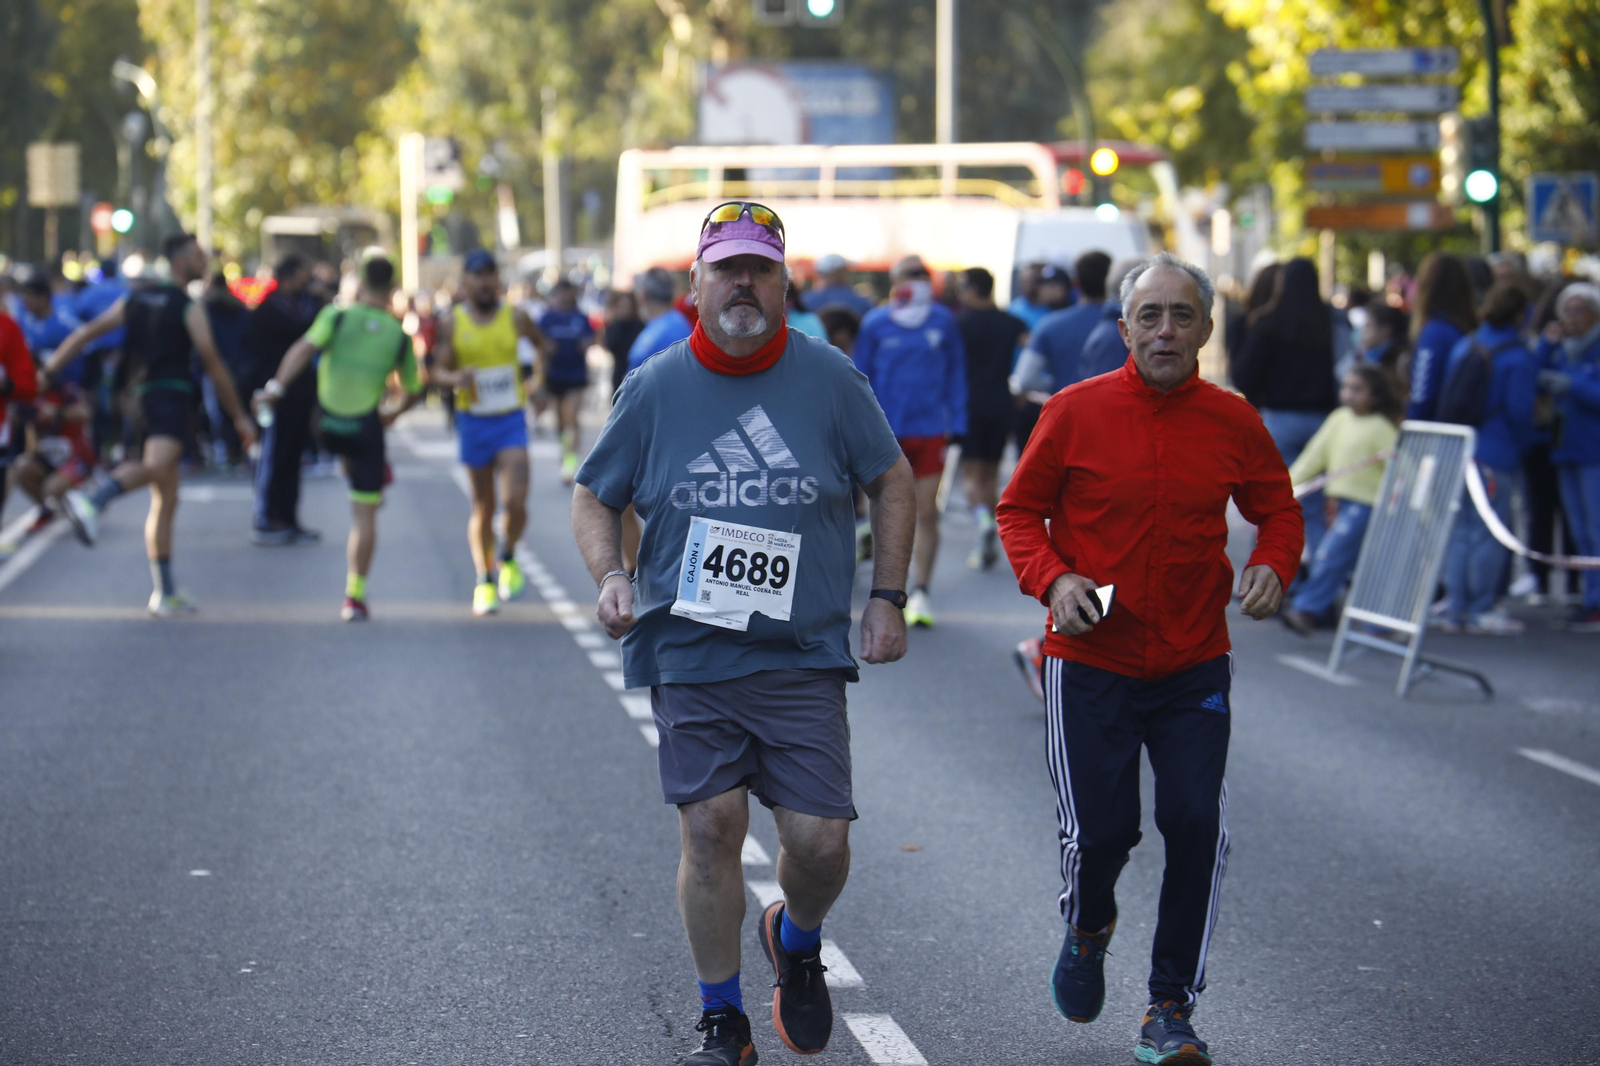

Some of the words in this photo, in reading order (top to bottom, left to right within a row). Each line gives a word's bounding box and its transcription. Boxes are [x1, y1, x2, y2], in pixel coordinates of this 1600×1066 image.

[670, 470, 820, 509] adidas
[721, 527, 765, 543] IMDECO
[687, 550, 699, 583] CAJÓN
[702, 544, 790, 589] 4689
[705, 578, 729, 587] ANTONIO
[730, 582, 752, 591] MANUEL
